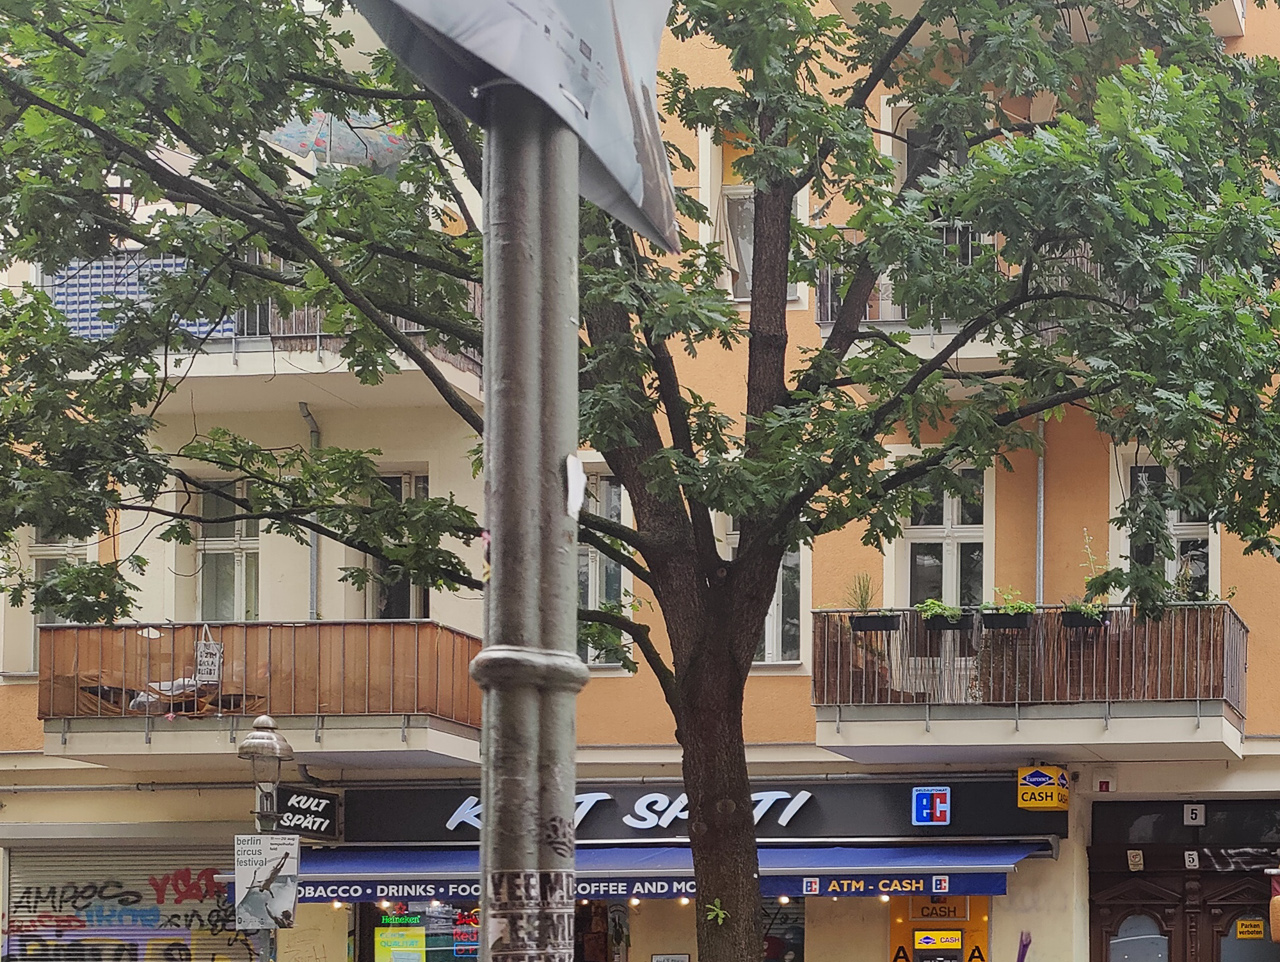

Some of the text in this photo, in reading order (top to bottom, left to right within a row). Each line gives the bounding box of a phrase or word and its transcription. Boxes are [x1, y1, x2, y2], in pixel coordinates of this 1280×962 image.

[1025, 775, 1050, 783] Euronet
[1021, 791, 1053, 802] CASH
[287, 794, 330, 812] KULT
[1190, 808, 1198, 820] 5
[280, 812, 330, 831] SPÄTI
[236, 836, 261, 846] berlin
[236, 848, 262, 856] circus
[236, 858, 267, 867] festival
[1188, 853, 1196, 864] 5
[376, 884, 436, 897] DRINKS
[448, 884, 481, 896] FOO
[632, 881, 669, 894] AND
[828, 880, 864, 891] ATM
[878, 879, 924, 891] CASH
[921, 906, 957, 918] CASH
[381, 915, 421, 924] Heineken
